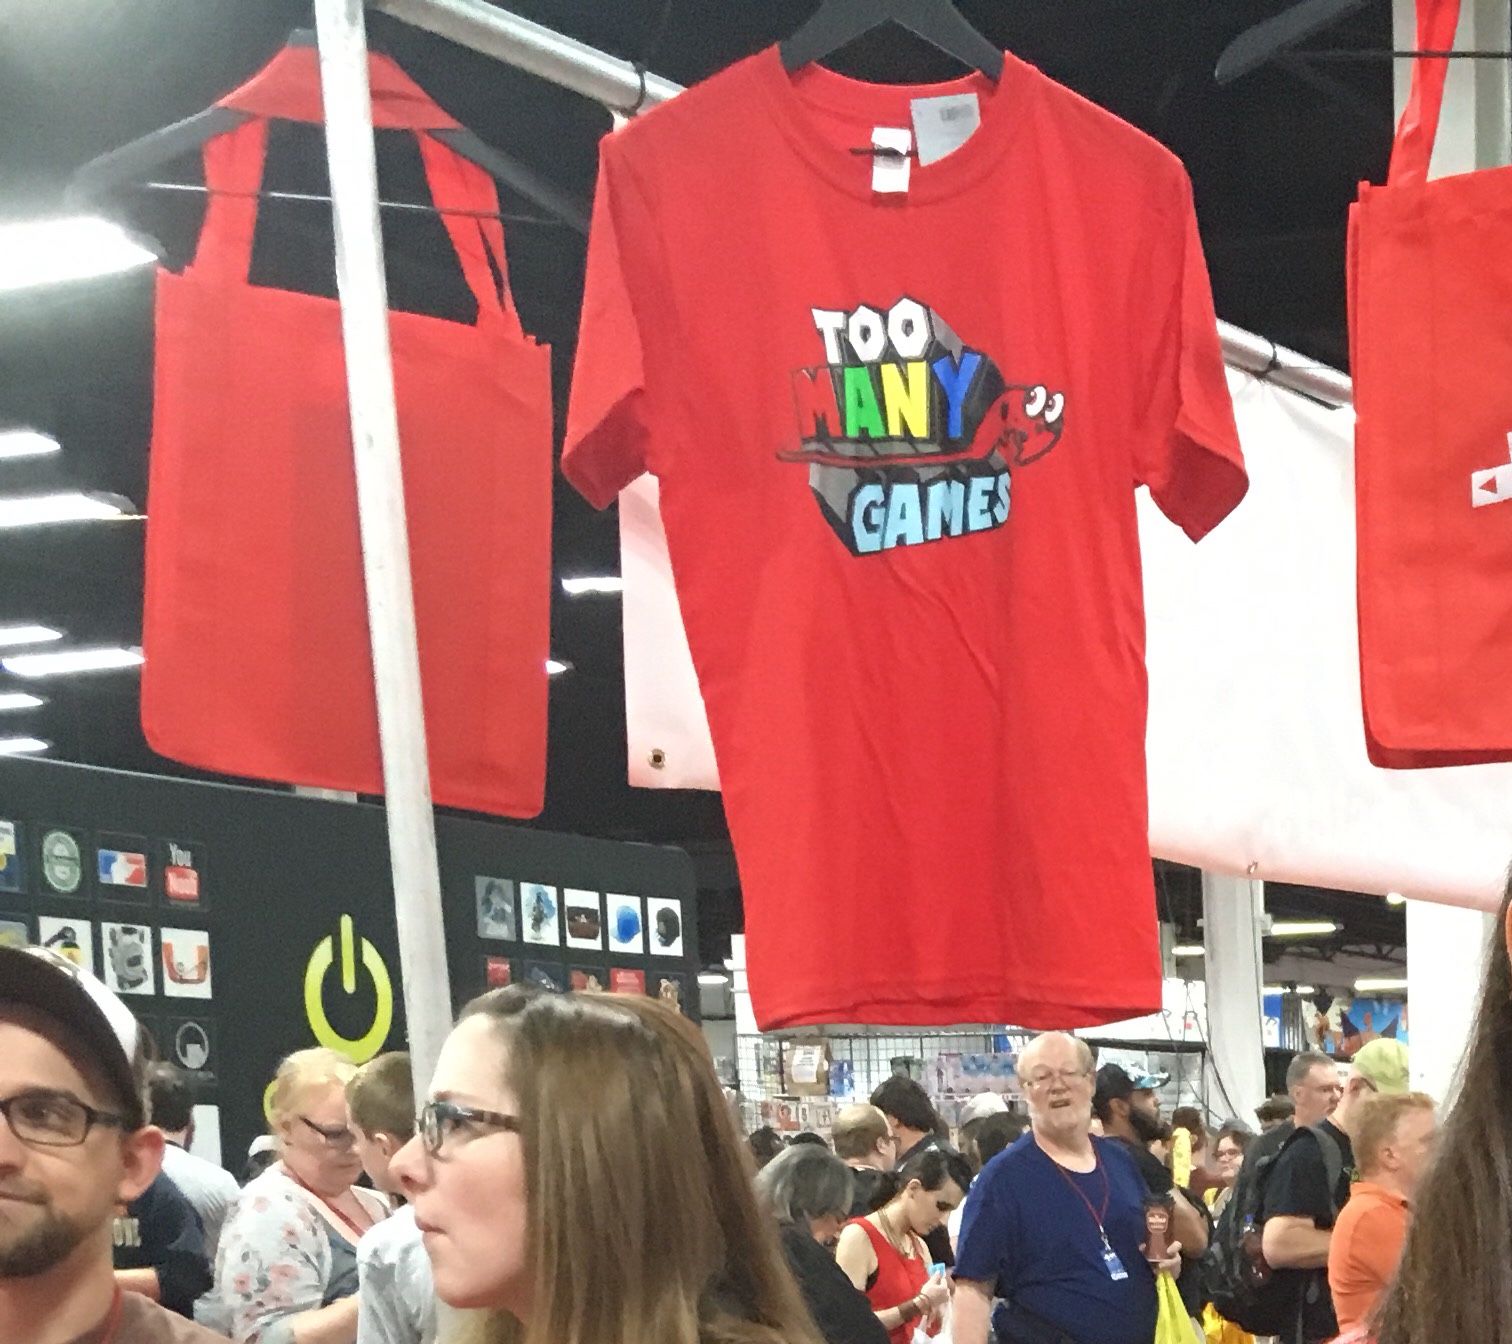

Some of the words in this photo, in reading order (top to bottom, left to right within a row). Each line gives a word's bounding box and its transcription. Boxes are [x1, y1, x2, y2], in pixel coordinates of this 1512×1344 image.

[811, 297, 932, 365] TOO
[793, 351, 982, 438] MANY
[850, 471, 1012, 554] GAMES
